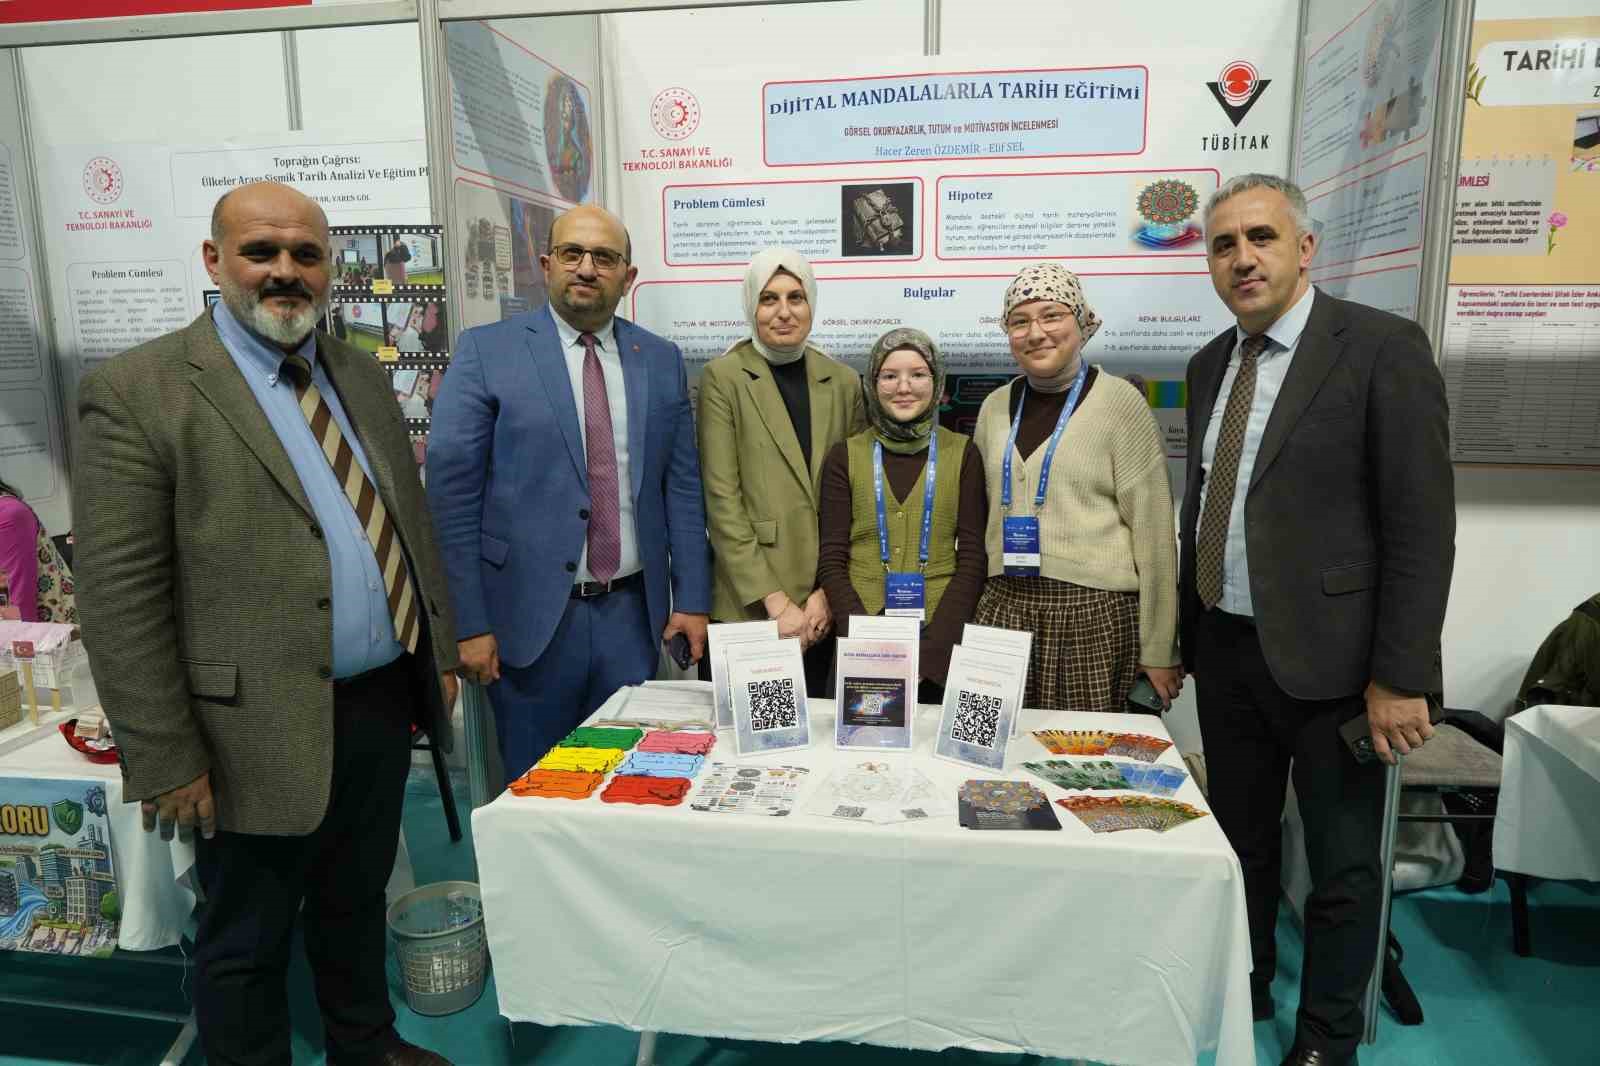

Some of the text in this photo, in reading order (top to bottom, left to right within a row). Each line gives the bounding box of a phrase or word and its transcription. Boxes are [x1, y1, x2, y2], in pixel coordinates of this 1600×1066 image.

[1503, 43, 1586, 71] TARİHİ
[769, 79, 1140, 115] DİJİTAL MANDALALARLA TARİH EĞİTİMİ
[844, 125, 871, 137] GÖRSEL
[928, 123, 952, 134] TUTUM
[953, 125, 962, 133] ve
[964, 121, 1009, 133] MOTİVASYON
[1011, 118, 1059, 131] İNCELENMESİ
[875, 145, 902, 157] Hacer
[905, 145, 931, 156] Zeren
[934, 142, 980, 155] ÖZDEMİR
[1006, 141, 1024, 152] SEL
[1202, 132, 1269, 151] TÜBİTAK
[640, 146, 711, 158] T.C. SANAYİ VE
[272, 154, 361, 168] Toprağın Çağrısı:
[623, 157, 732, 171] TEKNOLOJİ BAKANLIĞI
[201, 175, 236, 187] Ülkeler
[297, 170, 327, 182] Tarih
[330, 169, 365, 181] Analizi
[368, 168, 381, 178] Ve
[383, 167, 416, 180] Eğitim
[673, 197, 766, 210] Problem Cümlesi
[948, 190, 993, 203] Hipotez
[91, 269, 126, 280] Problem
[903, 287, 956, 300] Bulgular
[0, 805, 49, 836] ORU
